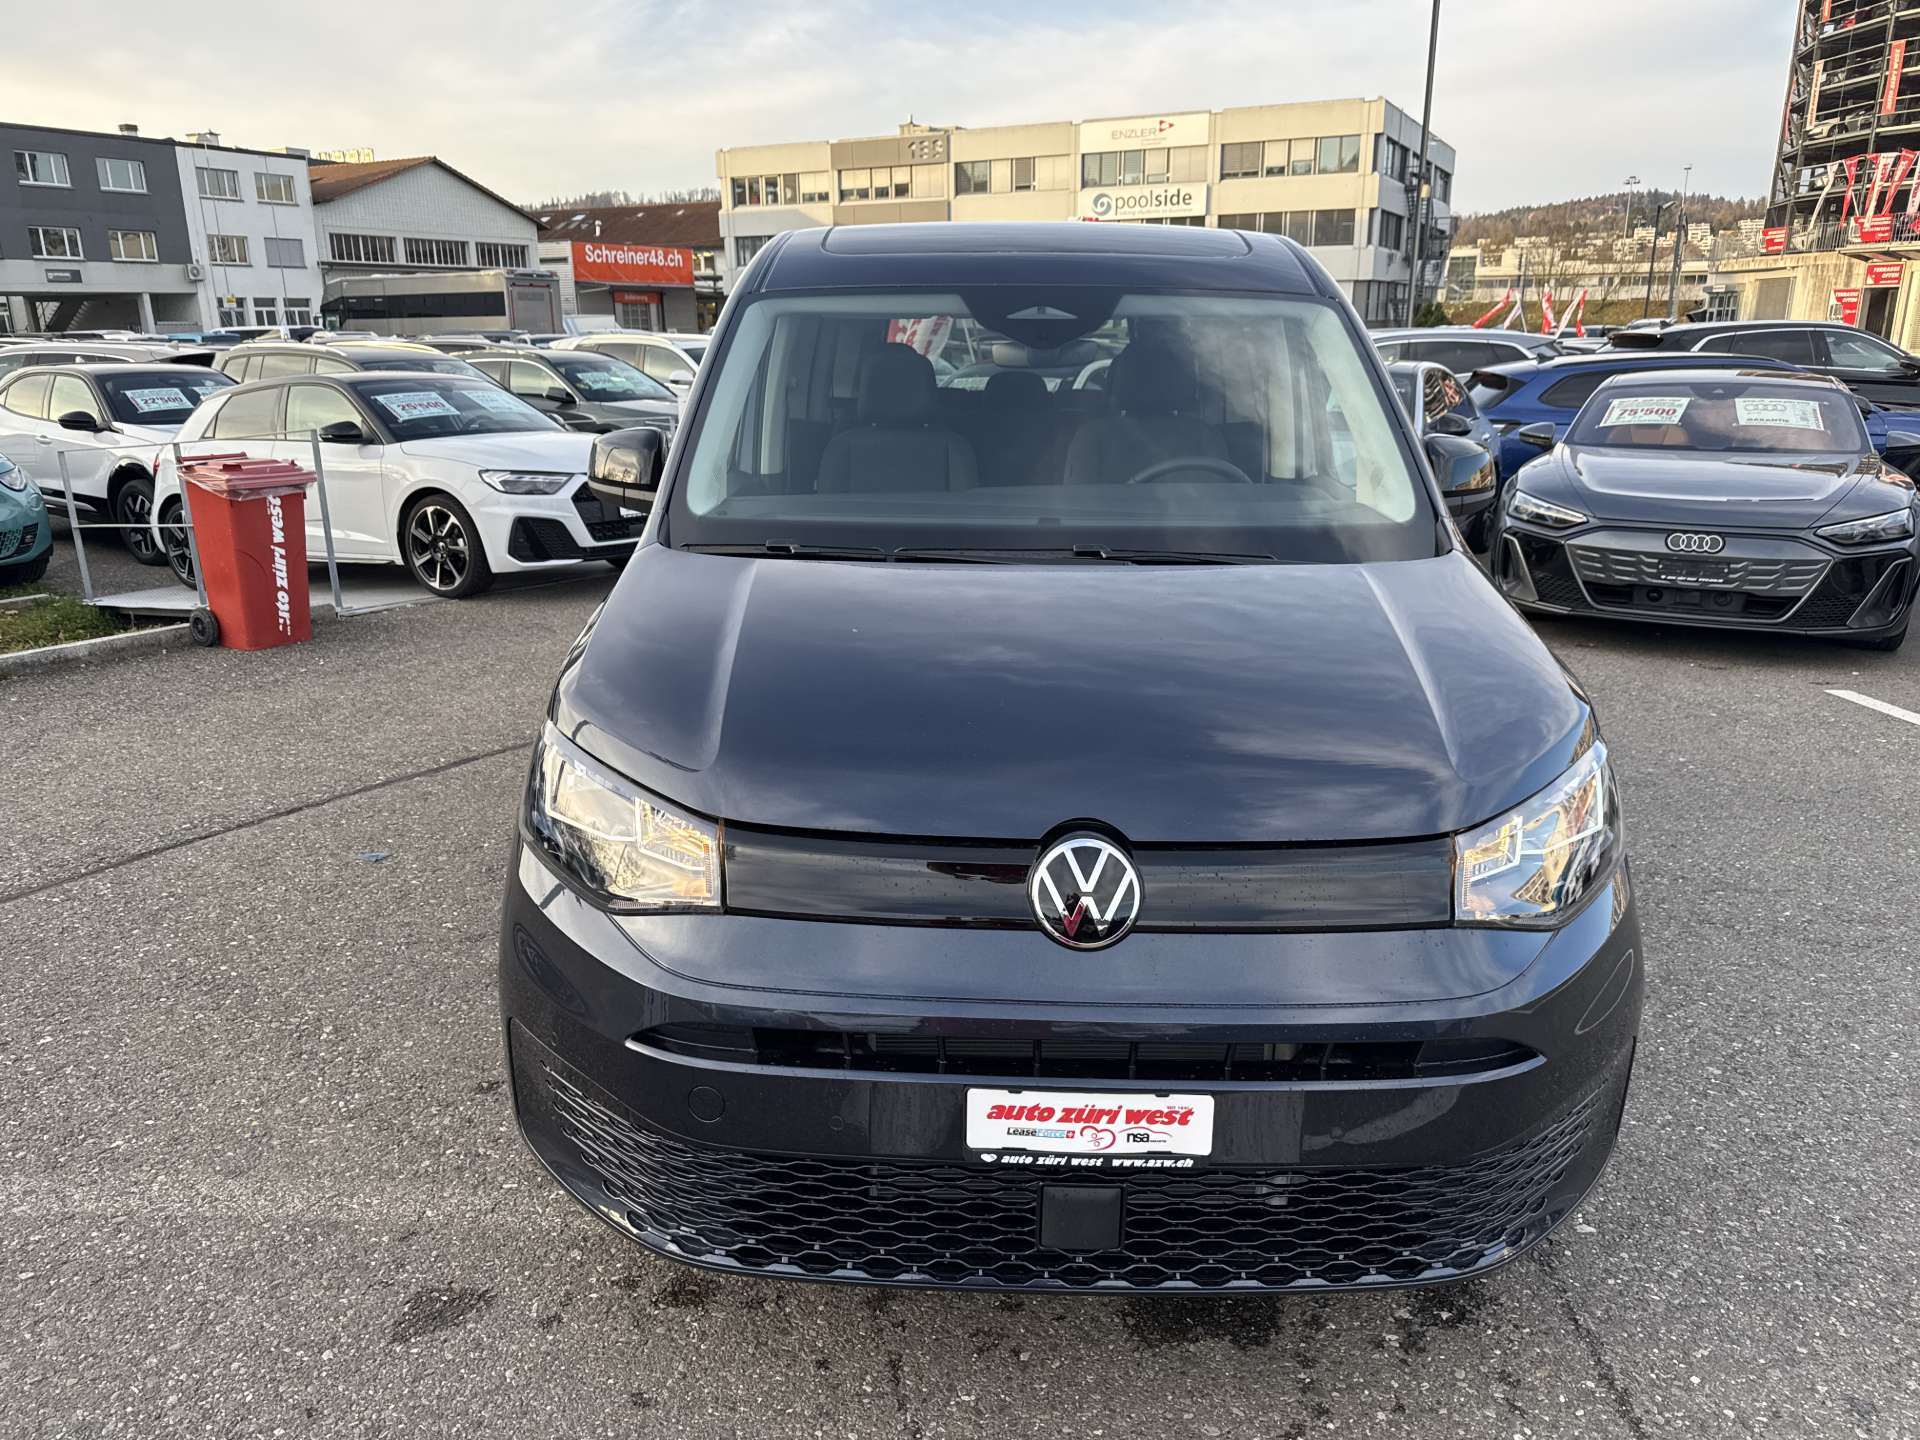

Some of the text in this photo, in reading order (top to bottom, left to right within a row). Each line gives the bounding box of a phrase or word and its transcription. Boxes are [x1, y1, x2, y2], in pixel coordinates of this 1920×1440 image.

[1111, 127, 1157, 140] ENZLER
[1115, 188, 1192, 216] poolside
[585, 244, 683, 267] Schreiner48.ch
[1618, 407, 1677, 417] 75'500
[270, 545, 289, 590] züri
[986, 1102, 1195, 1126] auto züri west
[1127, 1132, 1150, 1143] nsa
[1001, 1155, 1195, 1168] auto züri west www.azw.ch
